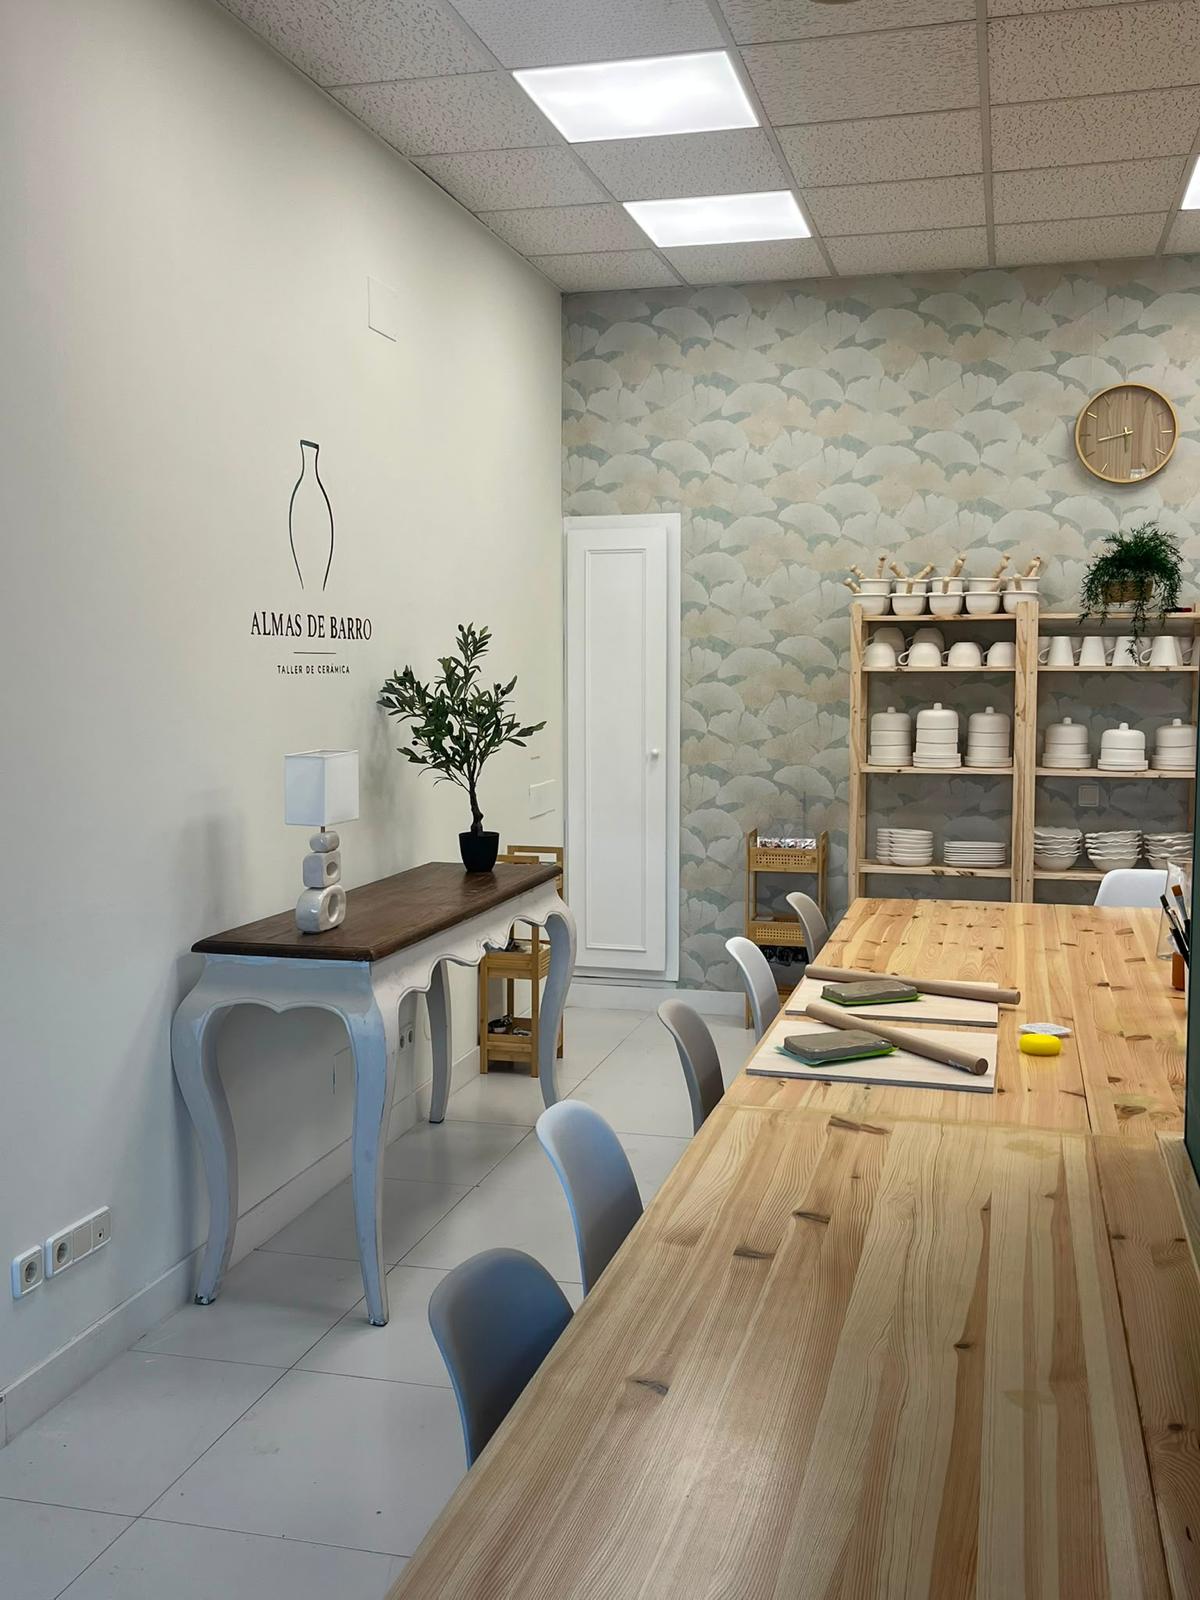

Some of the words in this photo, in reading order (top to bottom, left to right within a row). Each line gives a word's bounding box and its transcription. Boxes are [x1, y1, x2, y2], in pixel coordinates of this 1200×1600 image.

[250, 611, 302, 637] ALMAS
[307, 614, 325, 638] DE
[330, 616, 372, 640] BARRO
[277, 665, 303, 674] TALLER
[306, 665, 315, 674] DE
[317, 663, 350, 674] CERÁMICA
